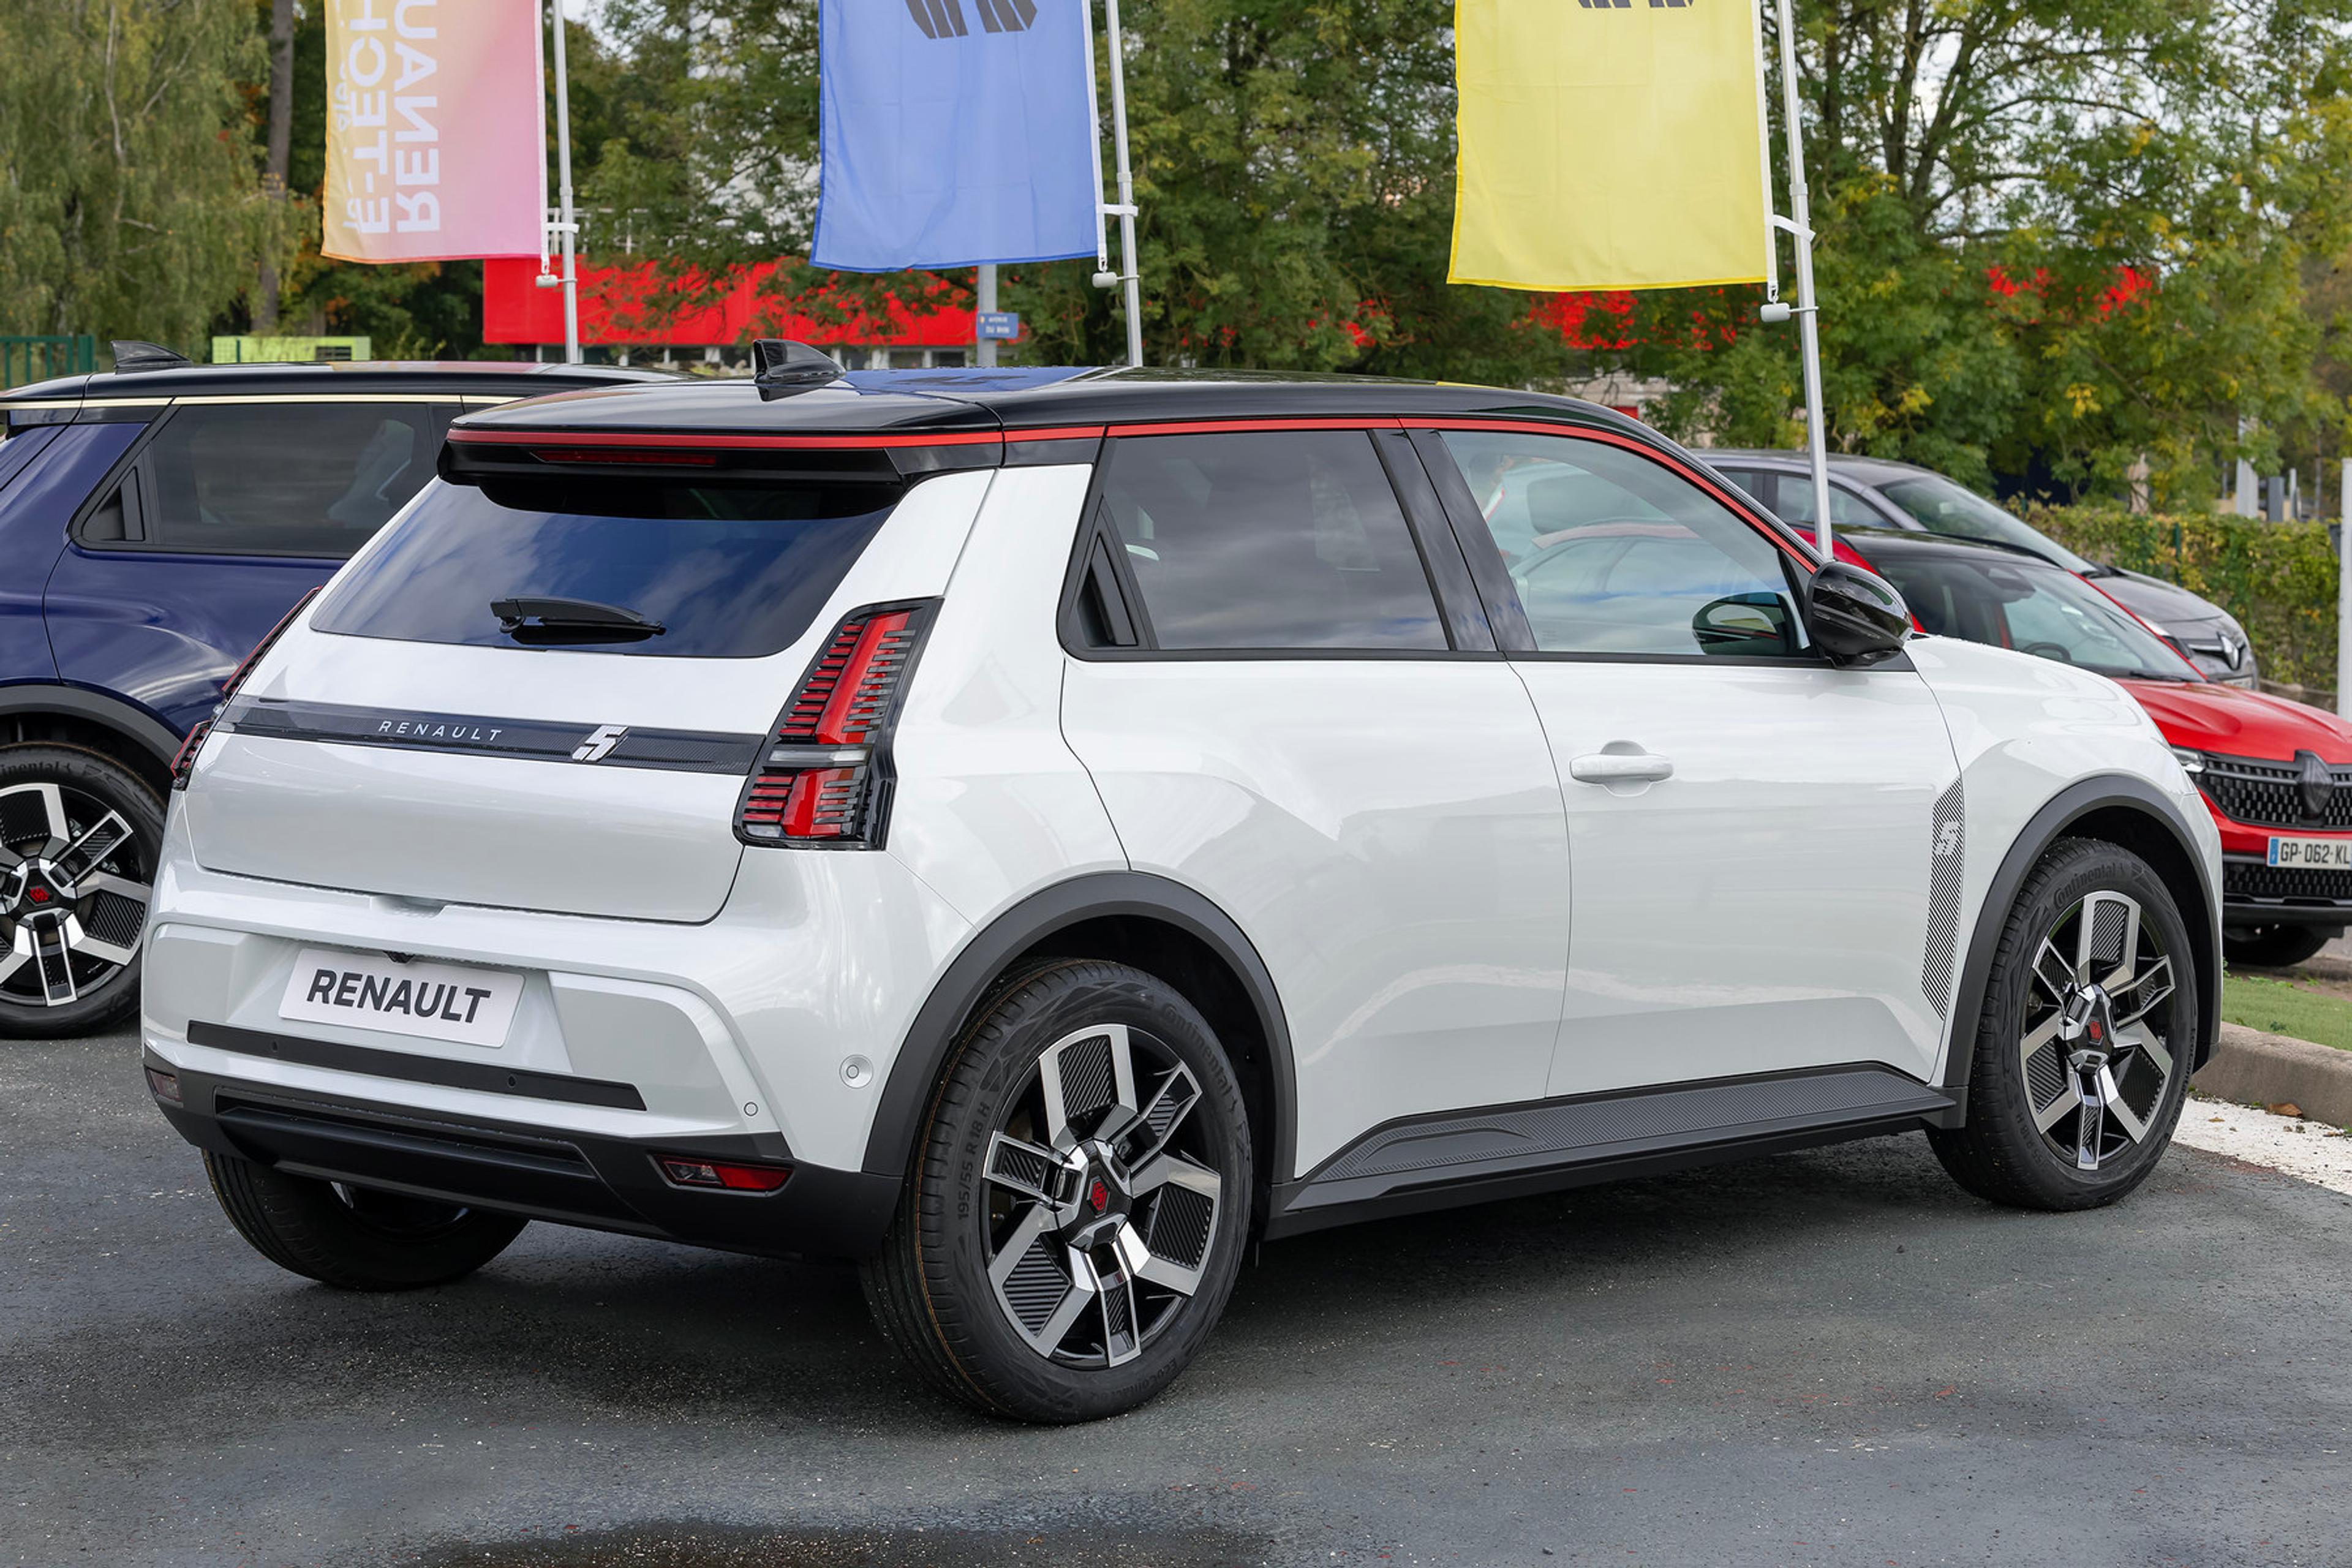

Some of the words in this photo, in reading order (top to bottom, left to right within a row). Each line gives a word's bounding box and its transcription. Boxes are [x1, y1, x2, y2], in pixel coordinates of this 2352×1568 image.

[378, 721, 502, 741] RENAULT
[2280, 842, 2350, 864] GP-062-KL
[2054, 862, 2116, 909] Continental
[307, 969, 492, 1023] RENAULT
[976, 1100, 990, 1117] H
[968, 1118, 984, 1139] 18
[964, 1140, 978, 1154] R
[957, 1160, 973, 1220] 195/55
